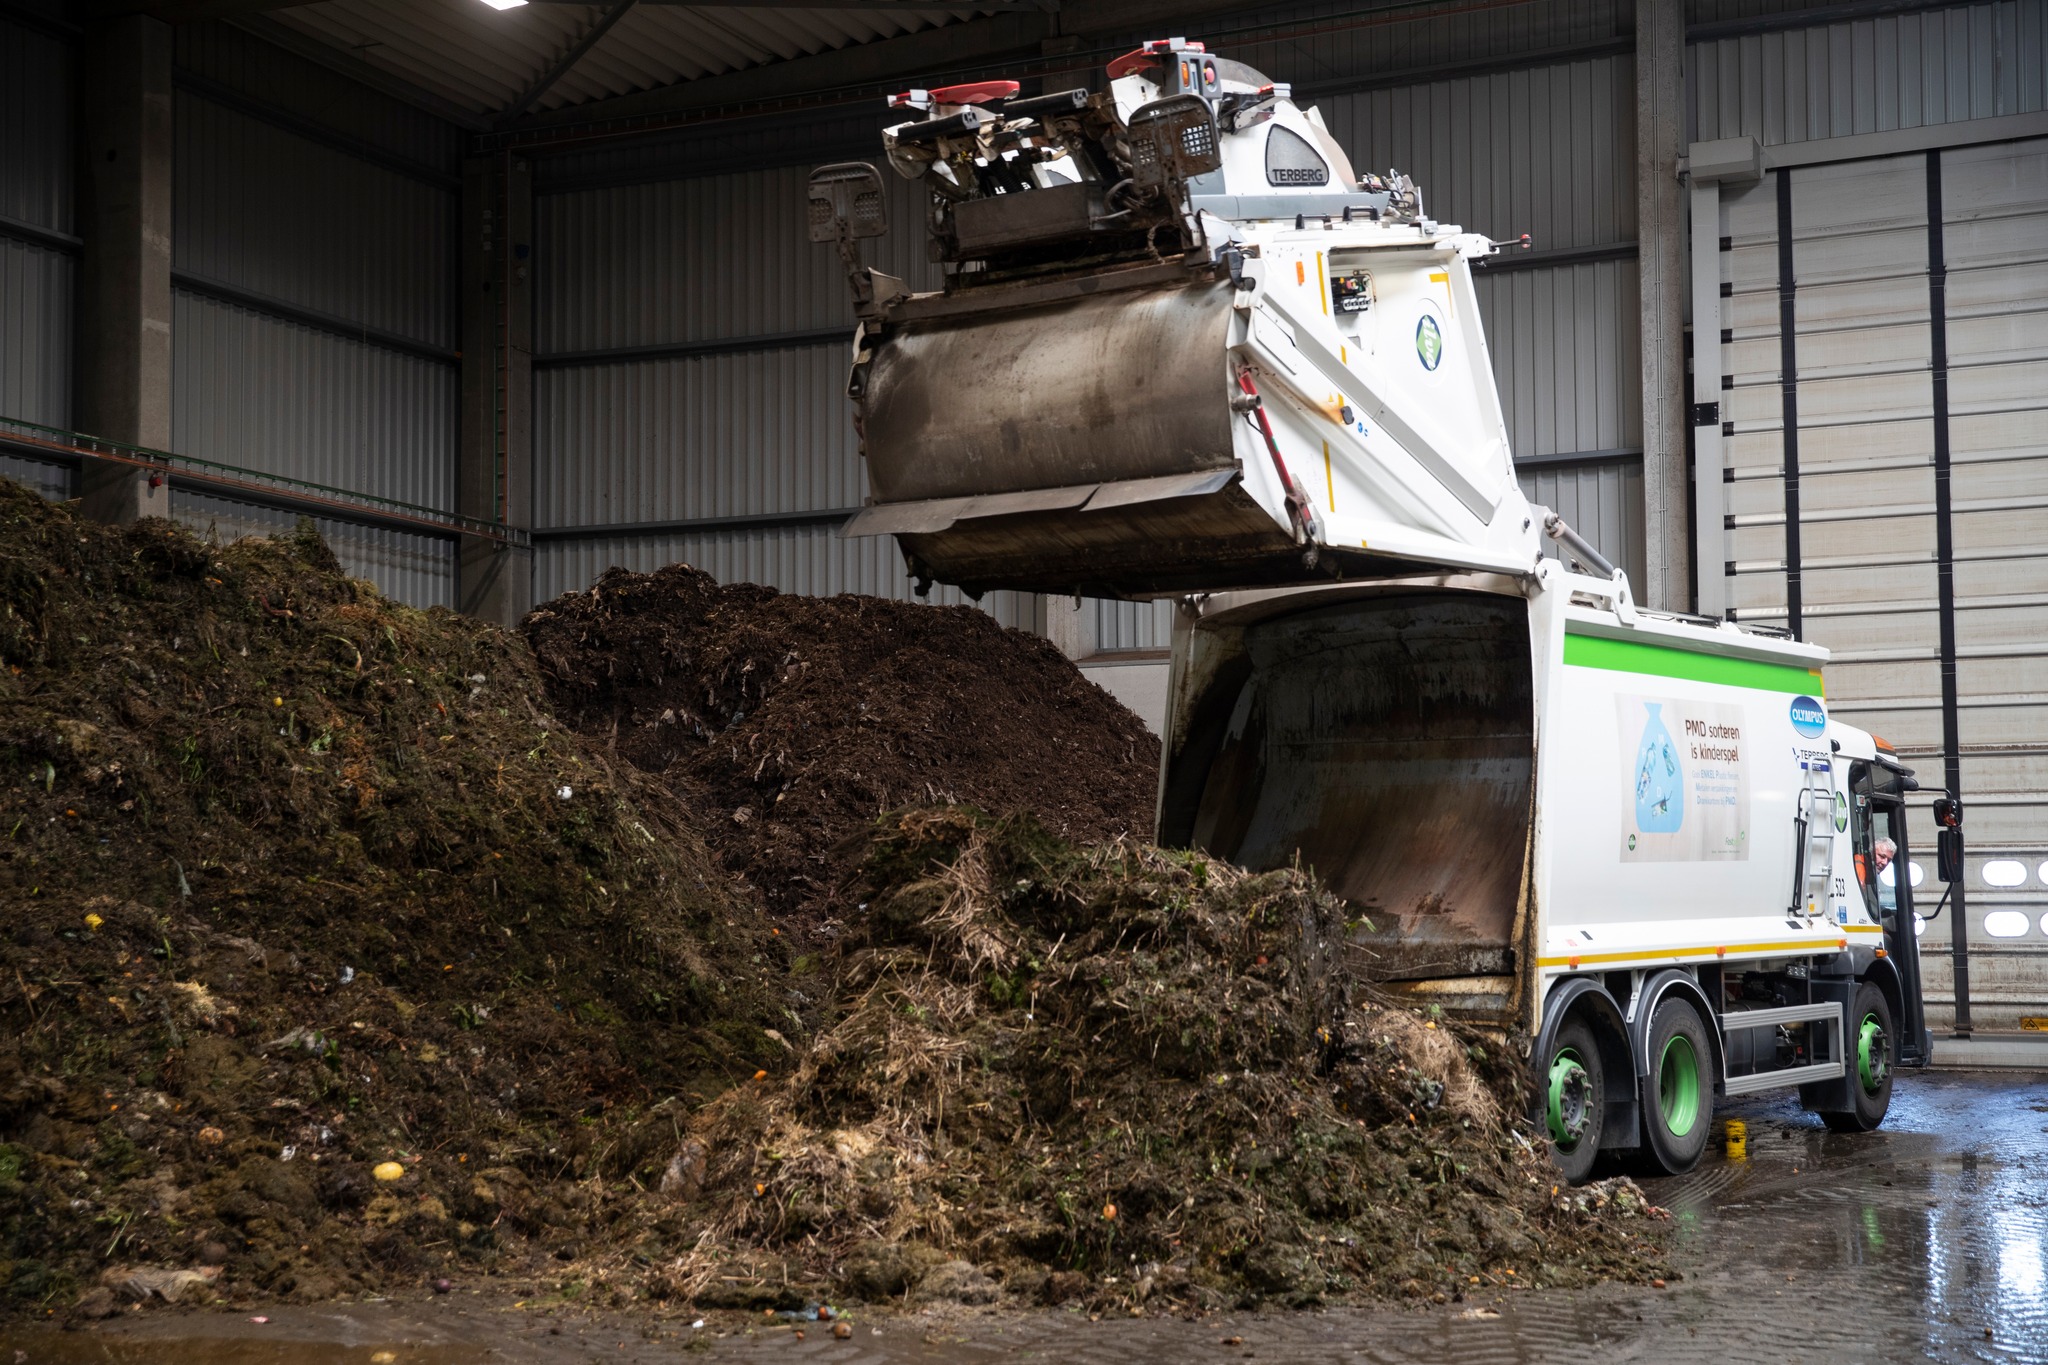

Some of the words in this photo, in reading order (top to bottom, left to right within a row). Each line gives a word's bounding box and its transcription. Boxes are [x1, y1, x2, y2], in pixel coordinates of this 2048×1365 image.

[1272, 169, 1323, 181] TERBERG
[1792, 708, 1824, 724] OLYMPUS
[1685, 719, 1706, 737] PMD
[1709, 723, 1740, 740] sorteren
[1690, 742, 1698, 760] is
[1699, 743, 1739, 765] kinderspel
[1835, 877, 1846, 897] 523
